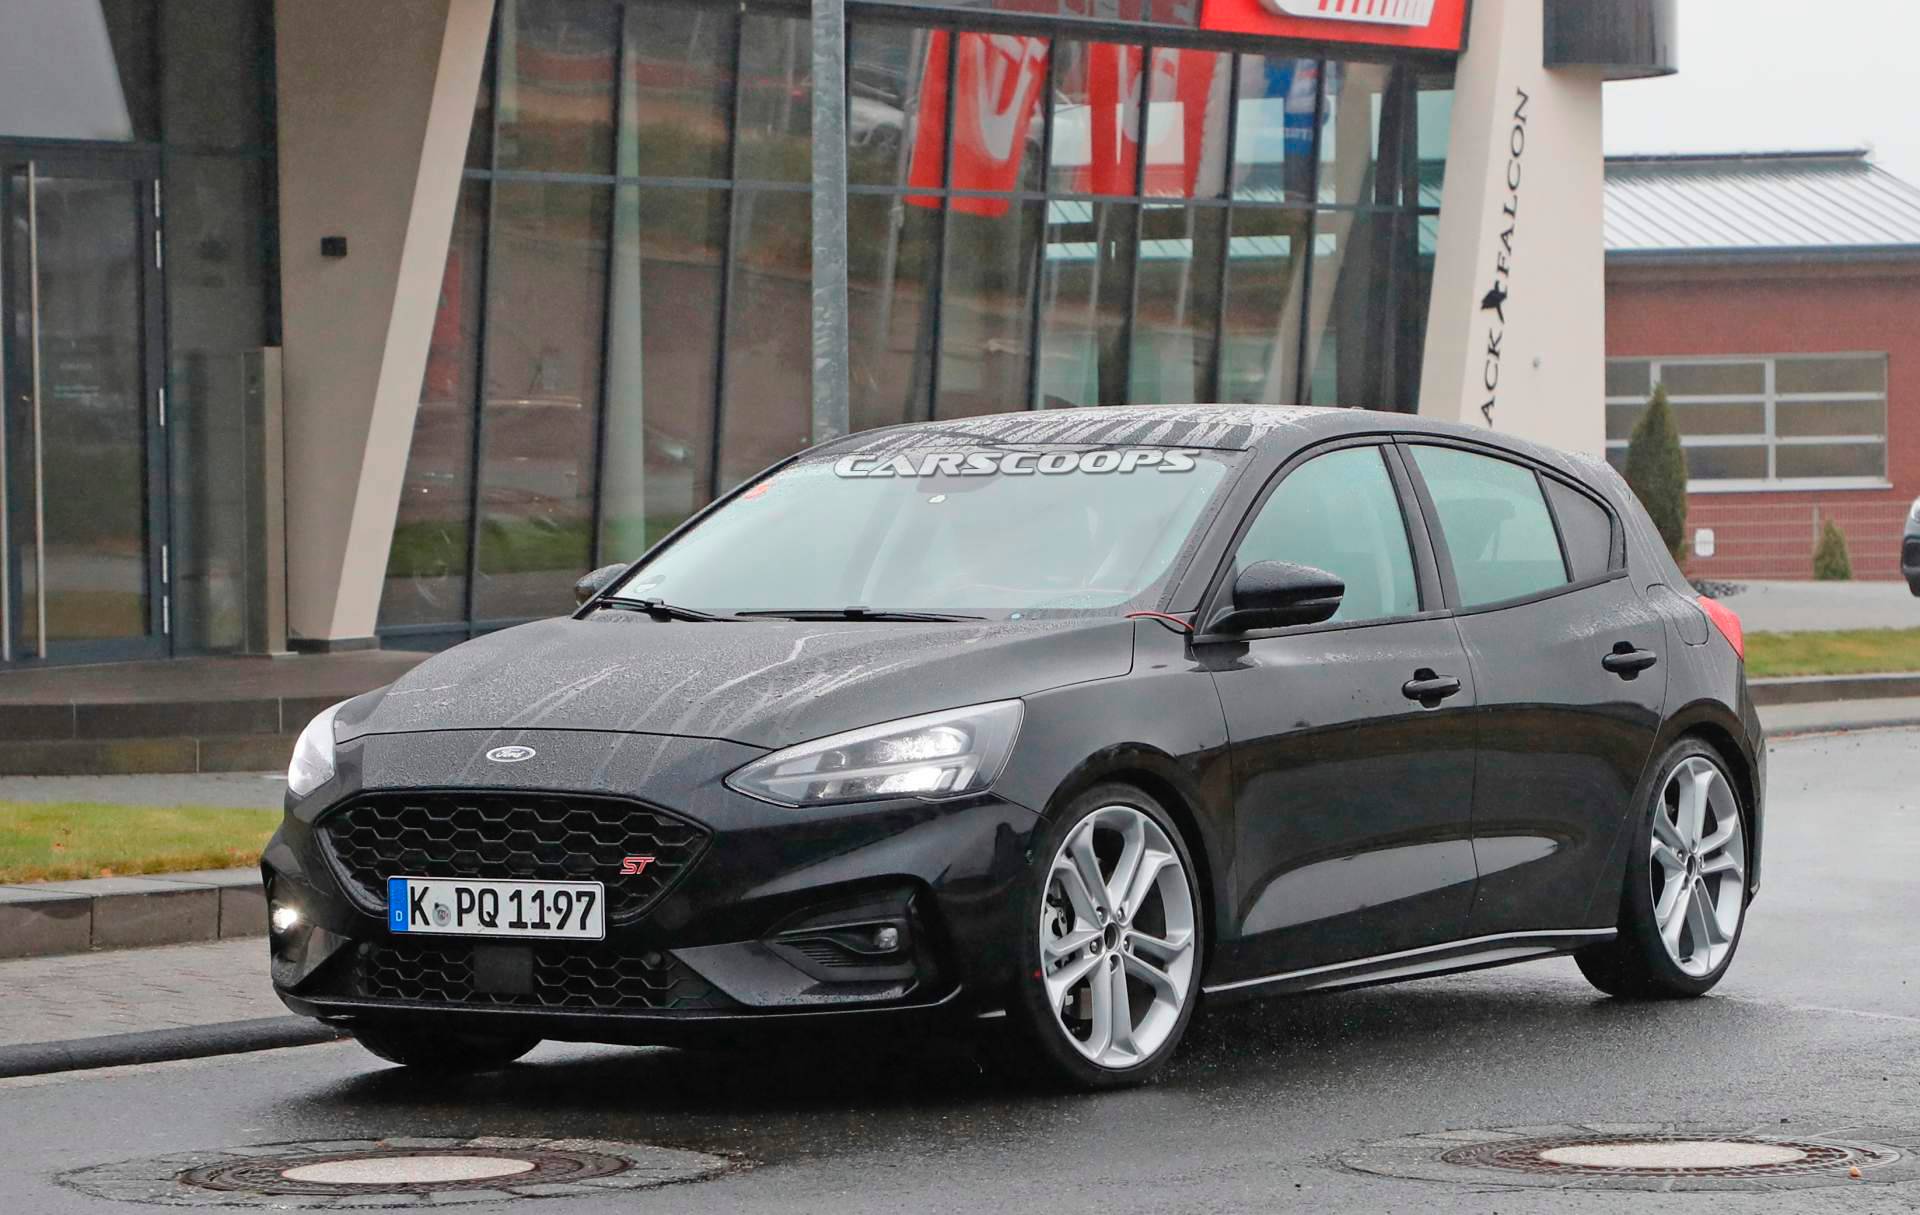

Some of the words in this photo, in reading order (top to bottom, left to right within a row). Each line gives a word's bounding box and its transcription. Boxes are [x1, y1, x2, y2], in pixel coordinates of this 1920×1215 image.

[1481, 328, 1502, 428] ACK
[1496, 86, 1529, 278] FALCON
[620, 856, 655, 874] ST
[395, 910, 403, 922] D
[410, 886, 430, 926] K
[455, 887, 499, 928] PQ
[508, 889, 596, 930] 1197
